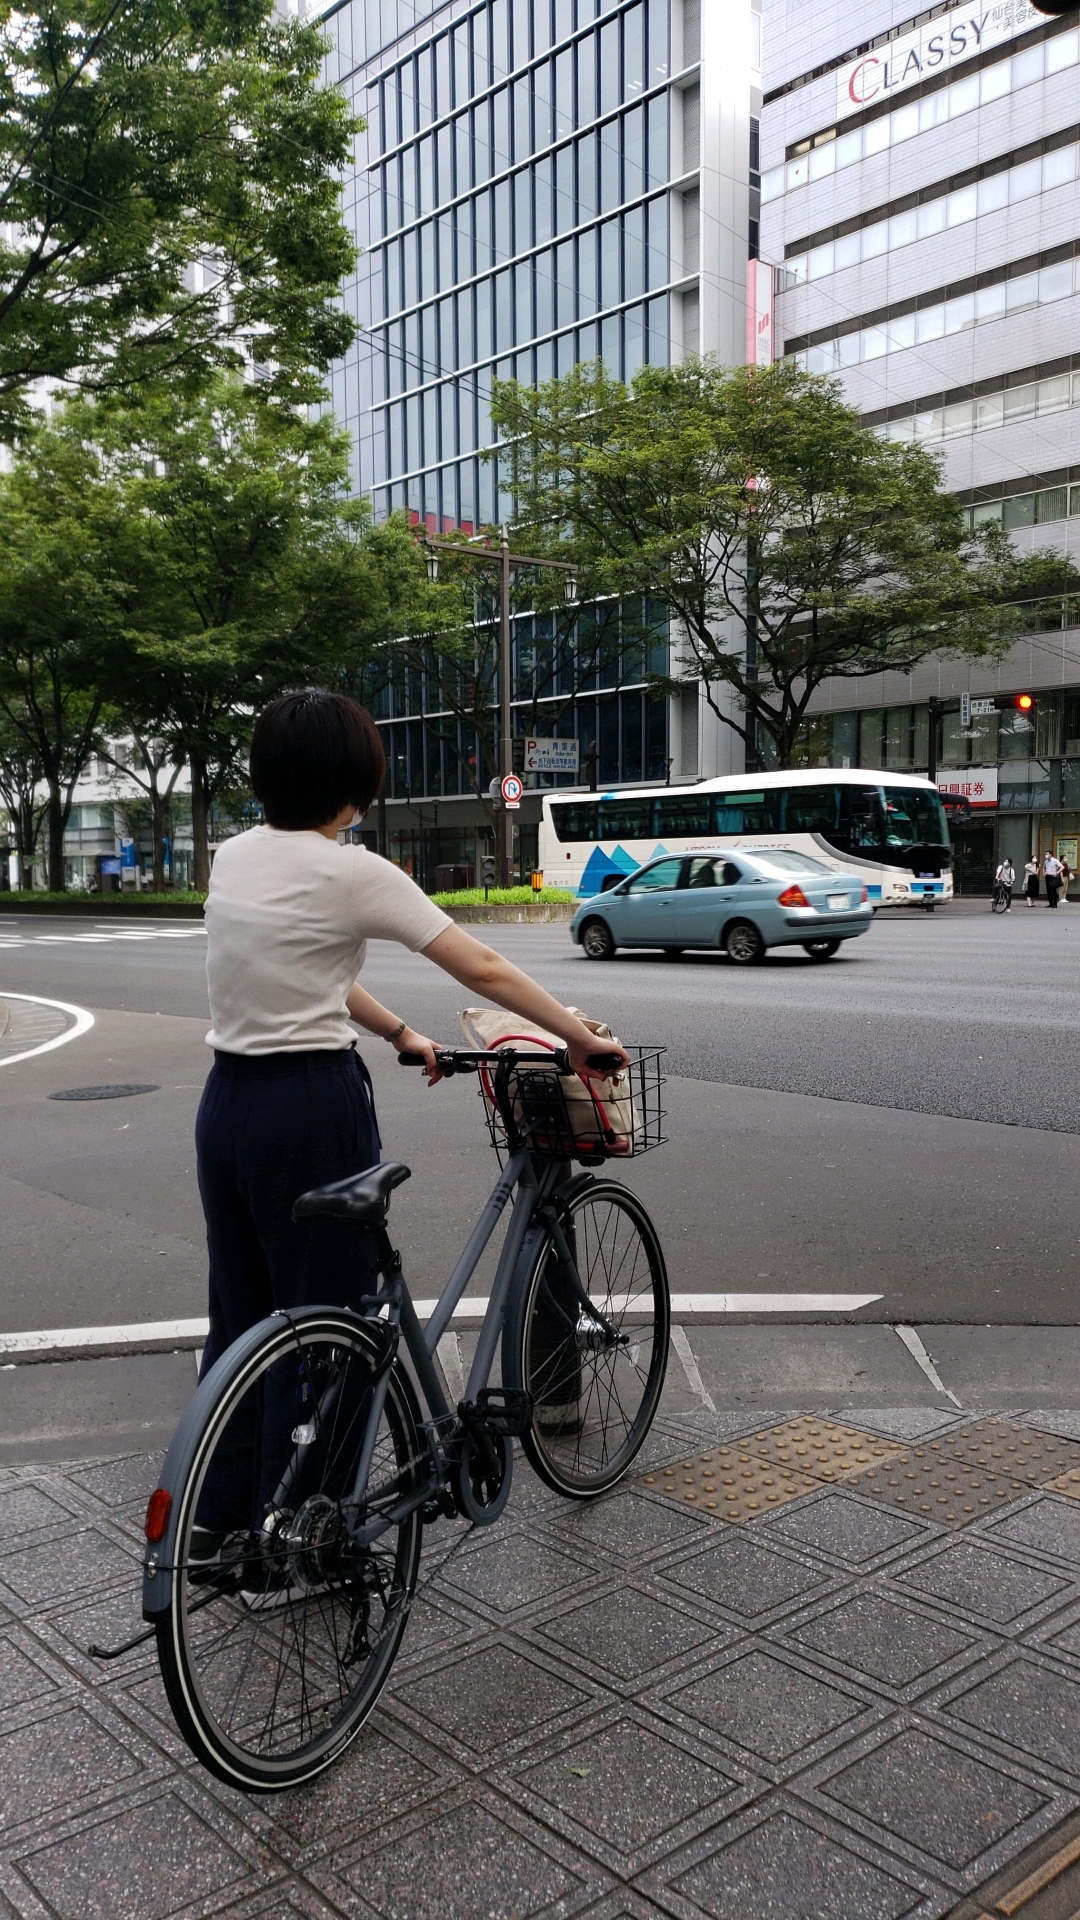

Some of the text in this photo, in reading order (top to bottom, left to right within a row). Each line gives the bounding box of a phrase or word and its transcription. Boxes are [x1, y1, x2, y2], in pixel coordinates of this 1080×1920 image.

[849, 11, 990, 103] CLASSY
[527, 741, 537, 754] P
[552, 742, 577, 751] 青葉通
[938, 782, 985, 796] 日興証券
